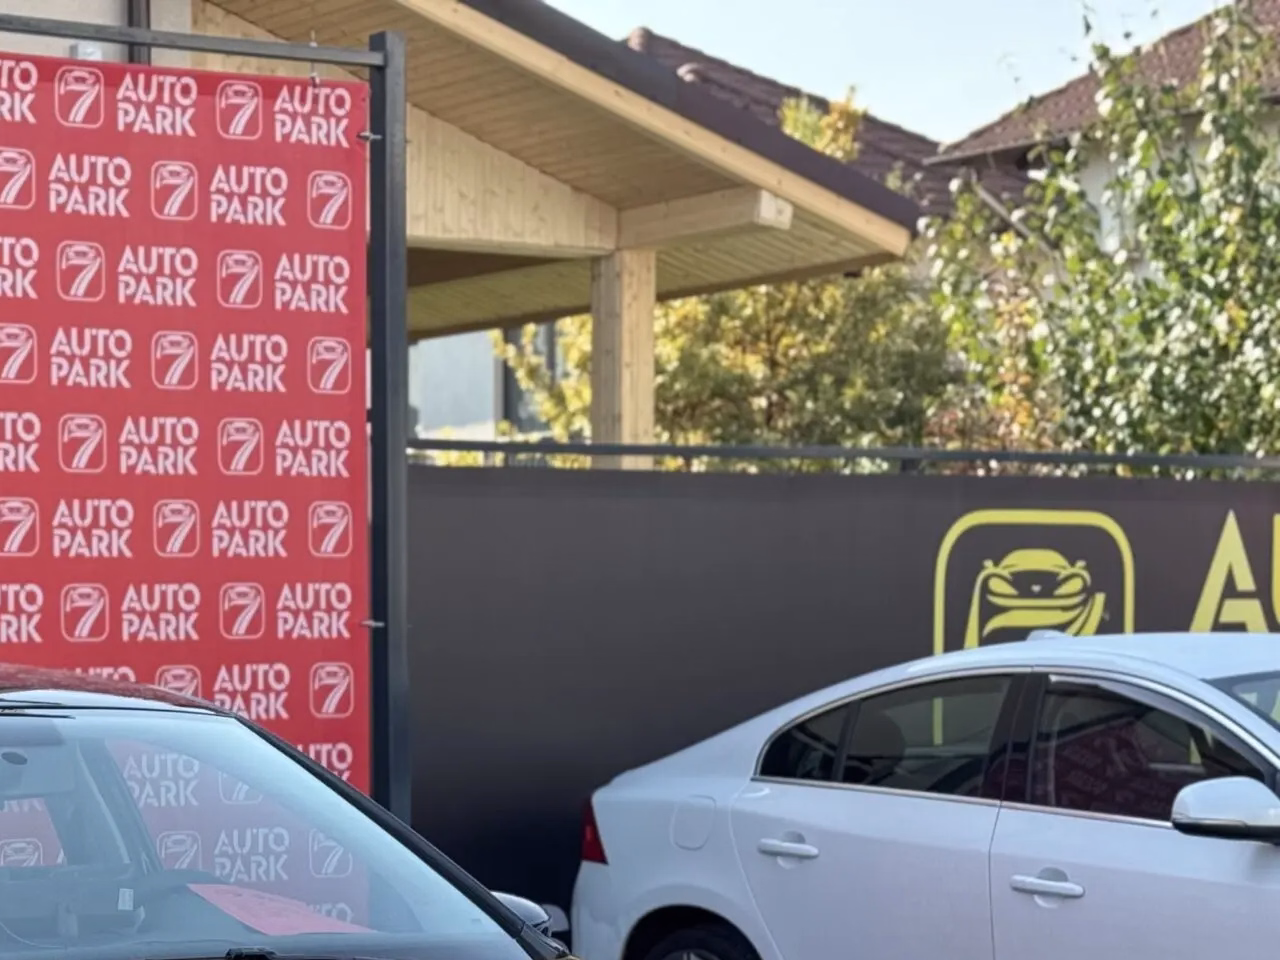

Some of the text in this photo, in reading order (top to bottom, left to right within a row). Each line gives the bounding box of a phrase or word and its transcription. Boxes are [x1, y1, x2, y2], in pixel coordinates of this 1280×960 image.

[116, 73, 197, 106] AUTO
[273, 86, 351, 117] AUTO
[117, 101, 196, 137] PARK
[274, 113, 349, 148] PARK
[48, 153, 132, 187] AUTO
[210, 164, 288, 197] AUTO
[49, 182, 130, 218] PARK
[210, 193, 286, 226] PARK
[117, 245, 198, 277] AUTO
[274, 253, 350, 285] AUTO
[118, 274, 196, 307] PARK
[275, 281, 348, 314] PARK
[50, 327, 132, 358] AUTO
[210, 334, 288, 363] AUTO
[51, 356, 131, 388] PARK
[211, 362, 286, 392] PARK
[119, 416, 199, 445] AUTO
[275, 420, 350, 449] AUTO
[120, 445, 197, 475] PARK
[276, 447, 349, 477] PARK
[52, 499, 134, 528] AUTO
[212, 500, 289, 528] AUTO
[53, 528, 132, 558] PARK
[212, 529, 287, 557] PARK
[121, 583, 200, 611] AUTO
[277, 583, 351, 610] AUTO
[122, 612, 199, 641] PARK
[277, 611, 350, 639] PARK
[214, 663, 290, 691] AUTO
[124, 754, 200, 778] AUTO
[214, 827, 290, 855] AUTO
